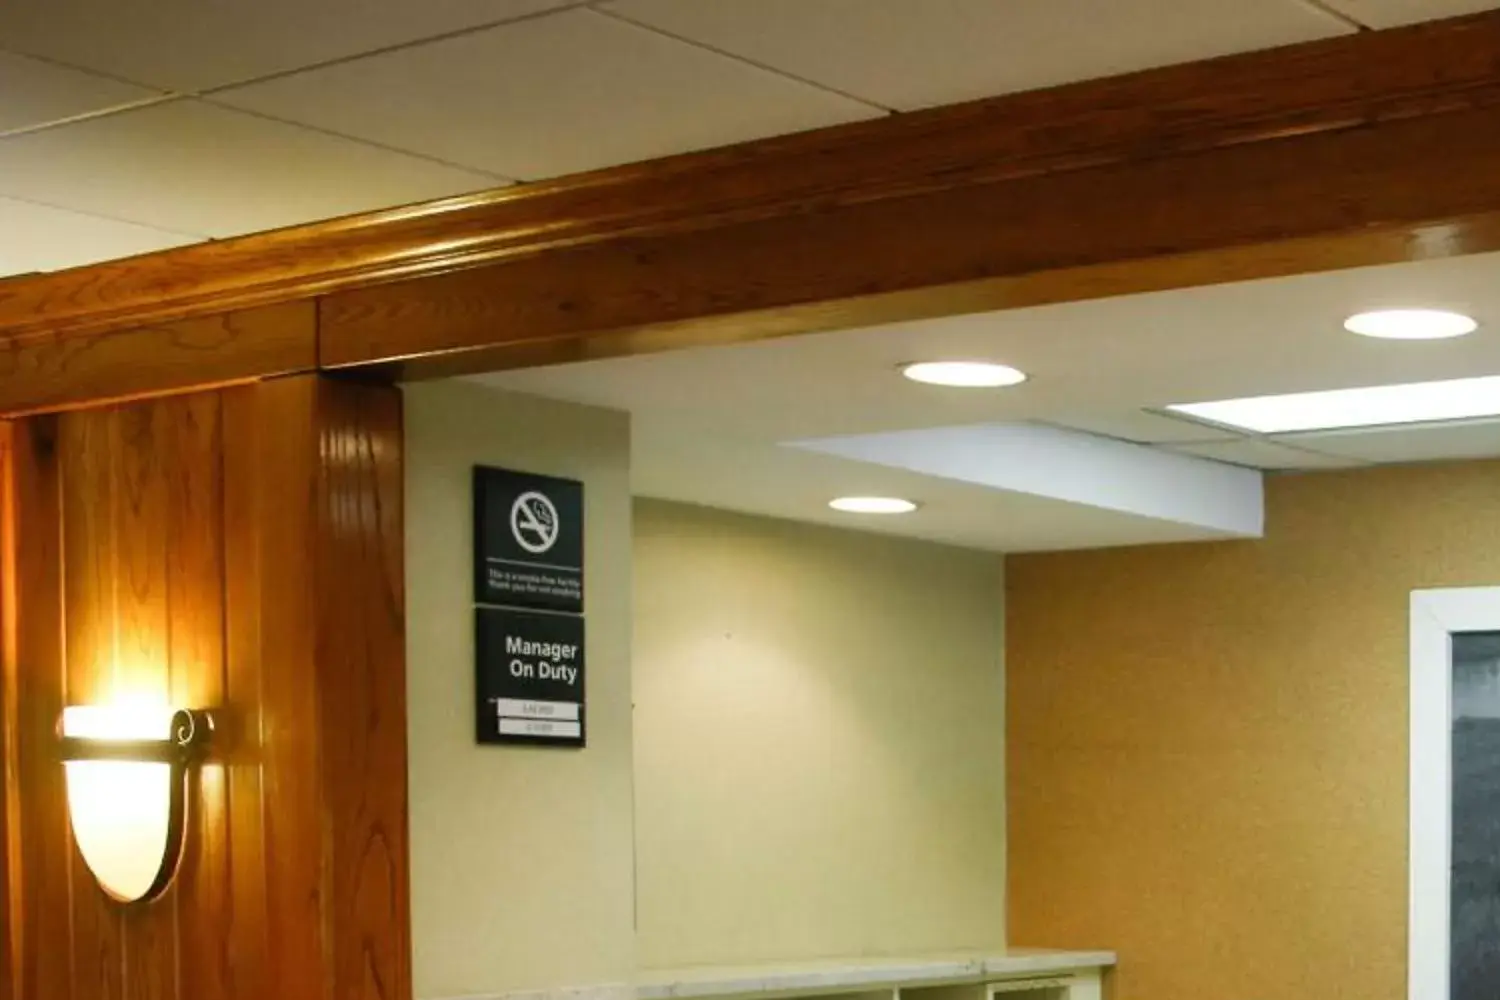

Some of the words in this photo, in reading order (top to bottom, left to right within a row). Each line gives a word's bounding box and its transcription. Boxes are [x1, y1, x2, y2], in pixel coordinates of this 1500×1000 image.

[505, 635, 578, 662] Manager
[510, 659, 533, 677] On
[539, 661, 577, 685] Duty
